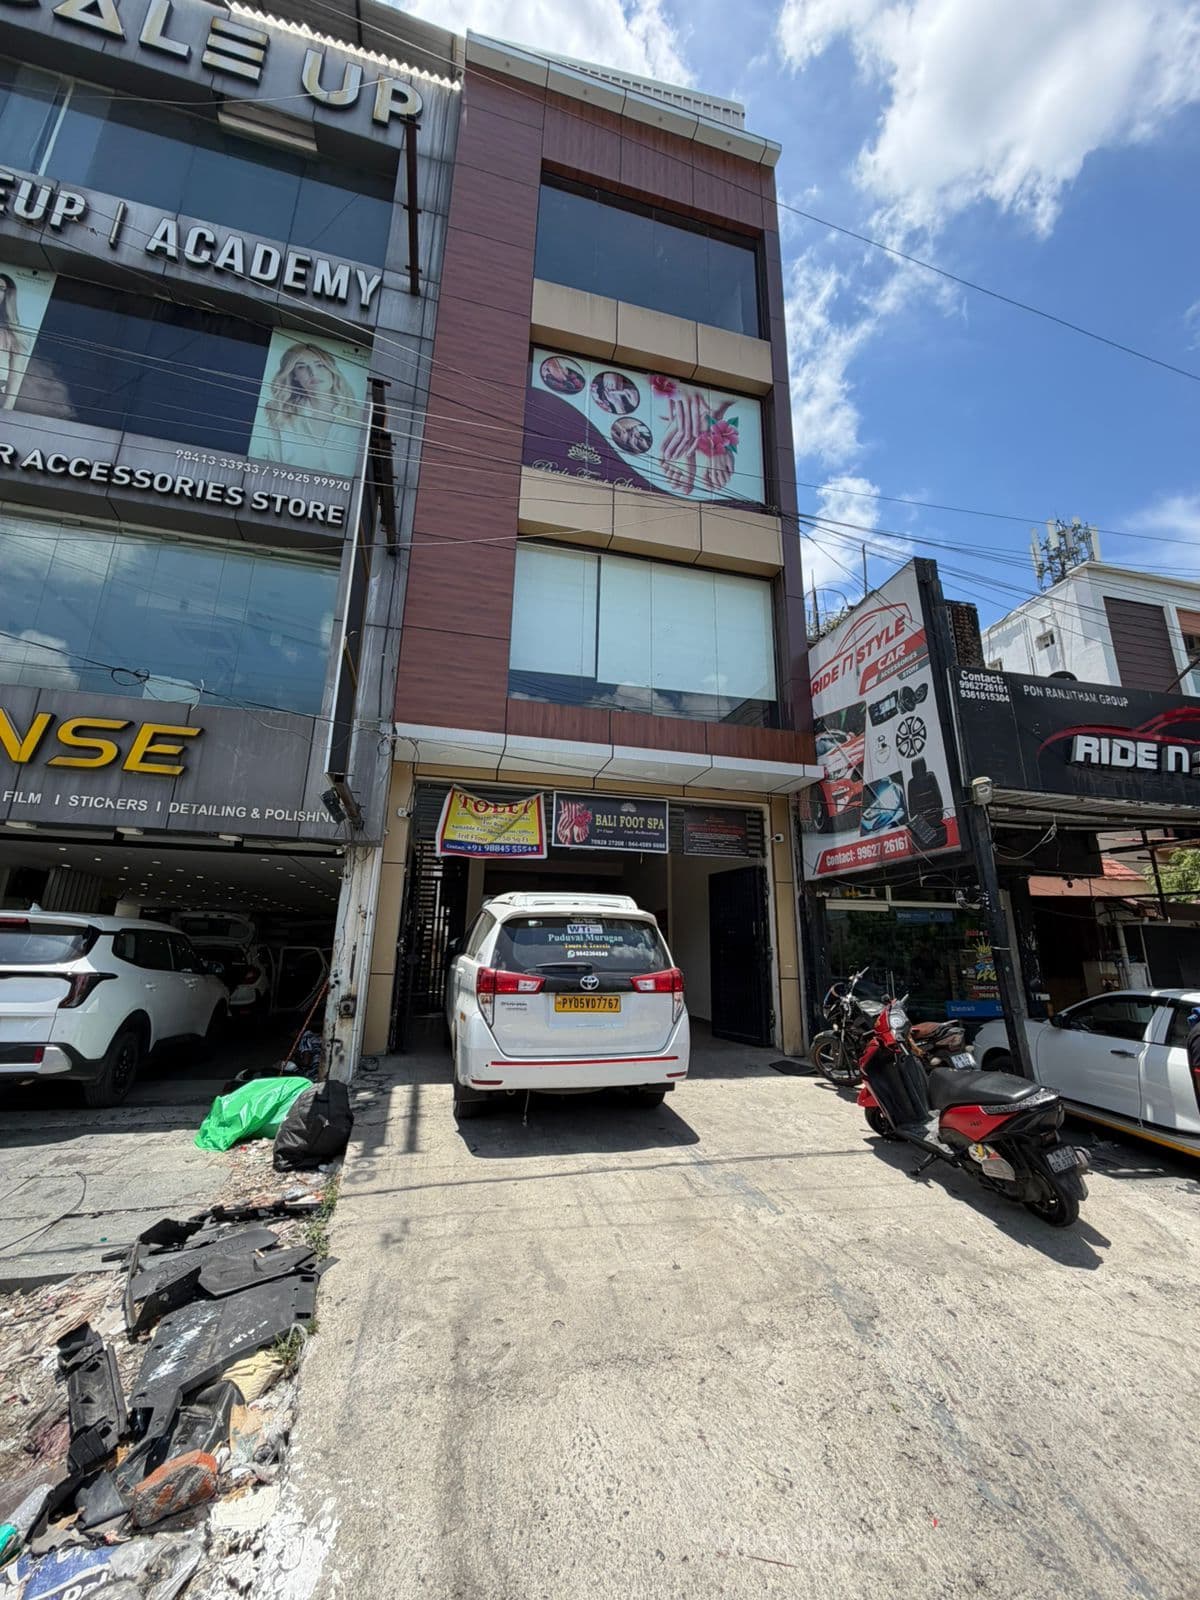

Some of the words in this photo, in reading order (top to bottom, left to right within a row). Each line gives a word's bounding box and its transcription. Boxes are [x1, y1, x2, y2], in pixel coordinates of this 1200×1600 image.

[0, 0, 271, 85] ALE
[301, 47, 424, 128] UP
[145, 217, 383, 309] ACADEMY
[20, 449, 244, 507] ACCESSORIES
[251, 494, 346, 526] STORE
[272, 468, 310, 484] 99625
[313, 476, 351, 491] 99970
[810, 664, 840, 697] RIDE
[855, 614, 906, 664] STYLE
[877, 644, 906, 670] CAR
[960, 670, 1004, 685] Contact:
[1023, 684, 1044, 697] PON
[1046, 688, 1098, 704] RANJITHAM
[1098, 694, 1129, 707] GROUP
[1073, 735, 1158, 770] RIDE
[3, 790, 42, 805] FILM
[68, 795, 148, 812] STICKERS
[168, 802, 247, 819] DETAILING
[251, 807, 261, 820] &
[595, 814, 617, 827] BALI
[619, 815, 644, 829] FOOT
[647, 817, 665, 830] SPA
[856, 843, 881, 860] 99627
[883, 836, 909, 854] 26161
[585, 933, 624, 943] Murugan
